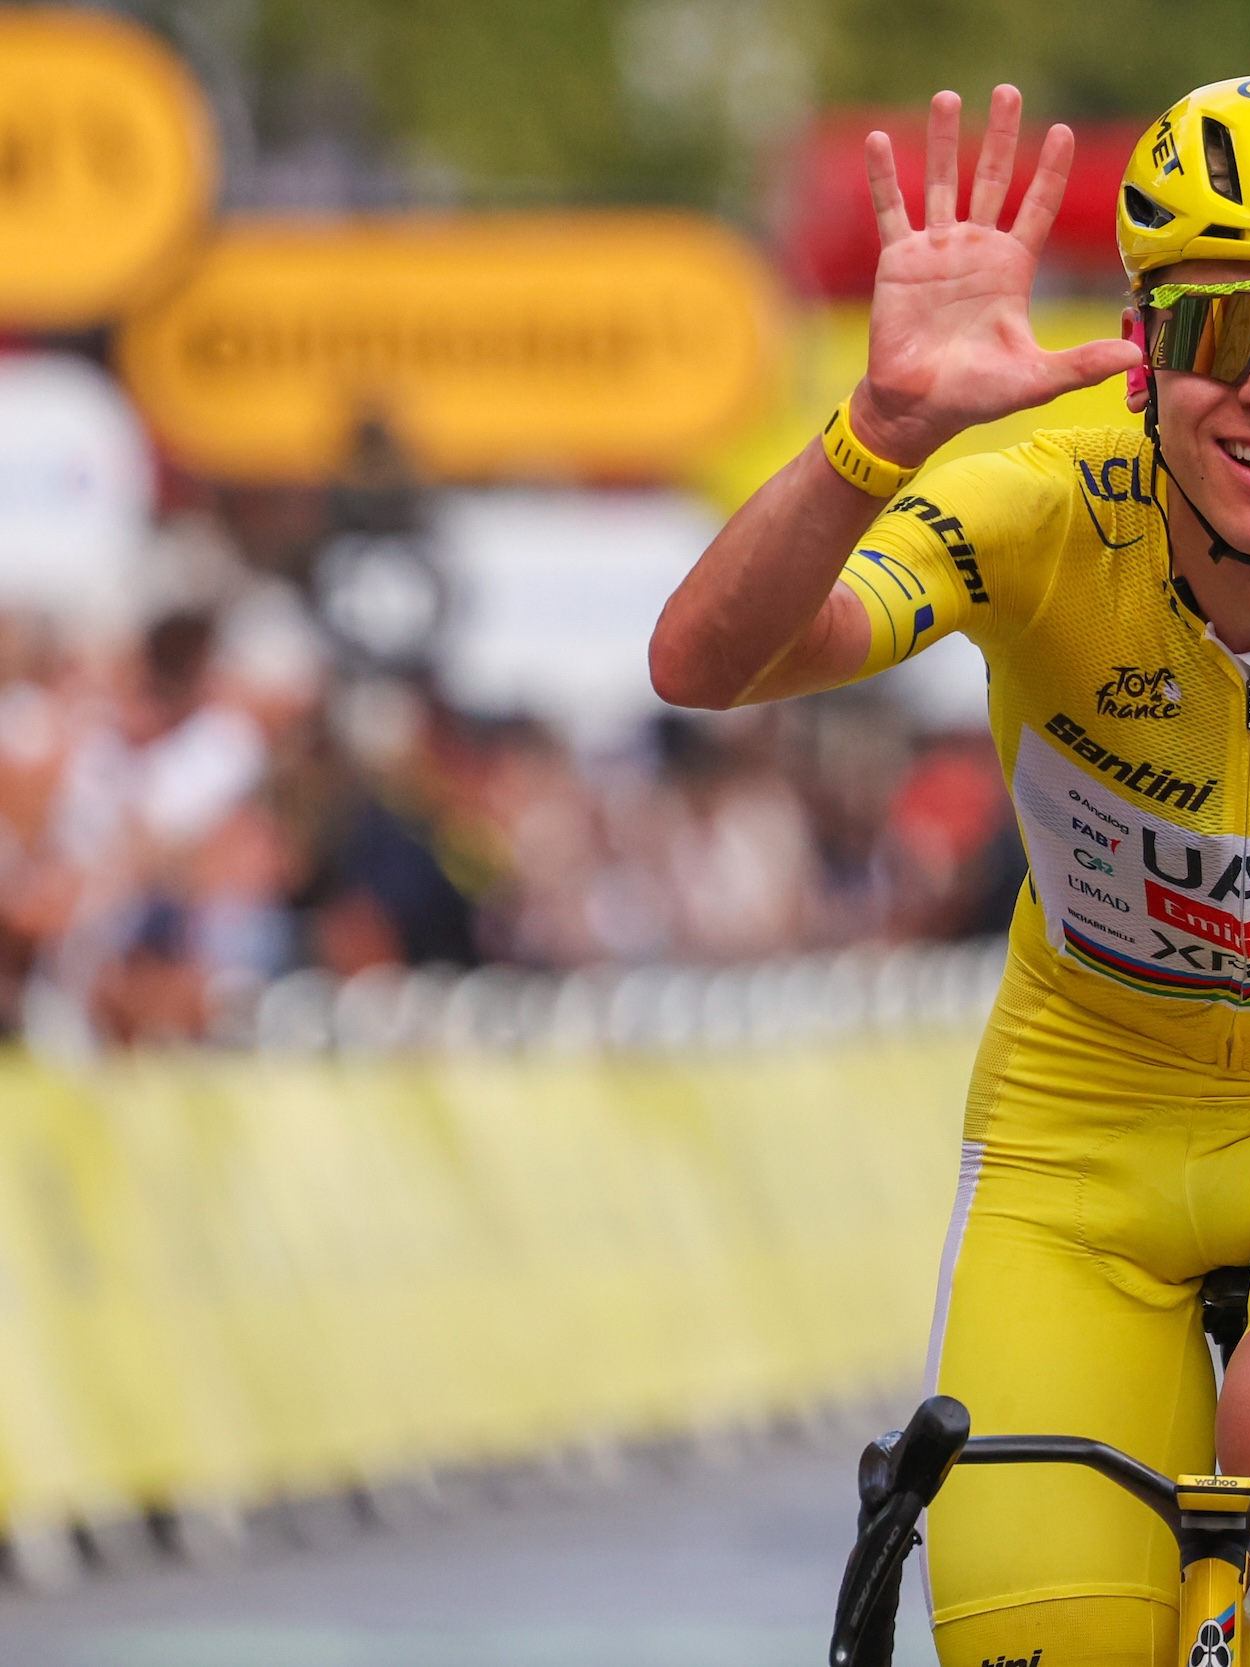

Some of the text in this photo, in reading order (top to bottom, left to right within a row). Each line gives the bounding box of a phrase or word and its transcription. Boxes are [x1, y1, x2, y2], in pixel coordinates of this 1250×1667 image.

[1079, 456, 1152, 506] LCL
[1081, 799, 1129, 835] Analog
[1068, 906, 1136, 944] RICHARD MILLE
[1195, 1476, 1238, 1487] wahoo
